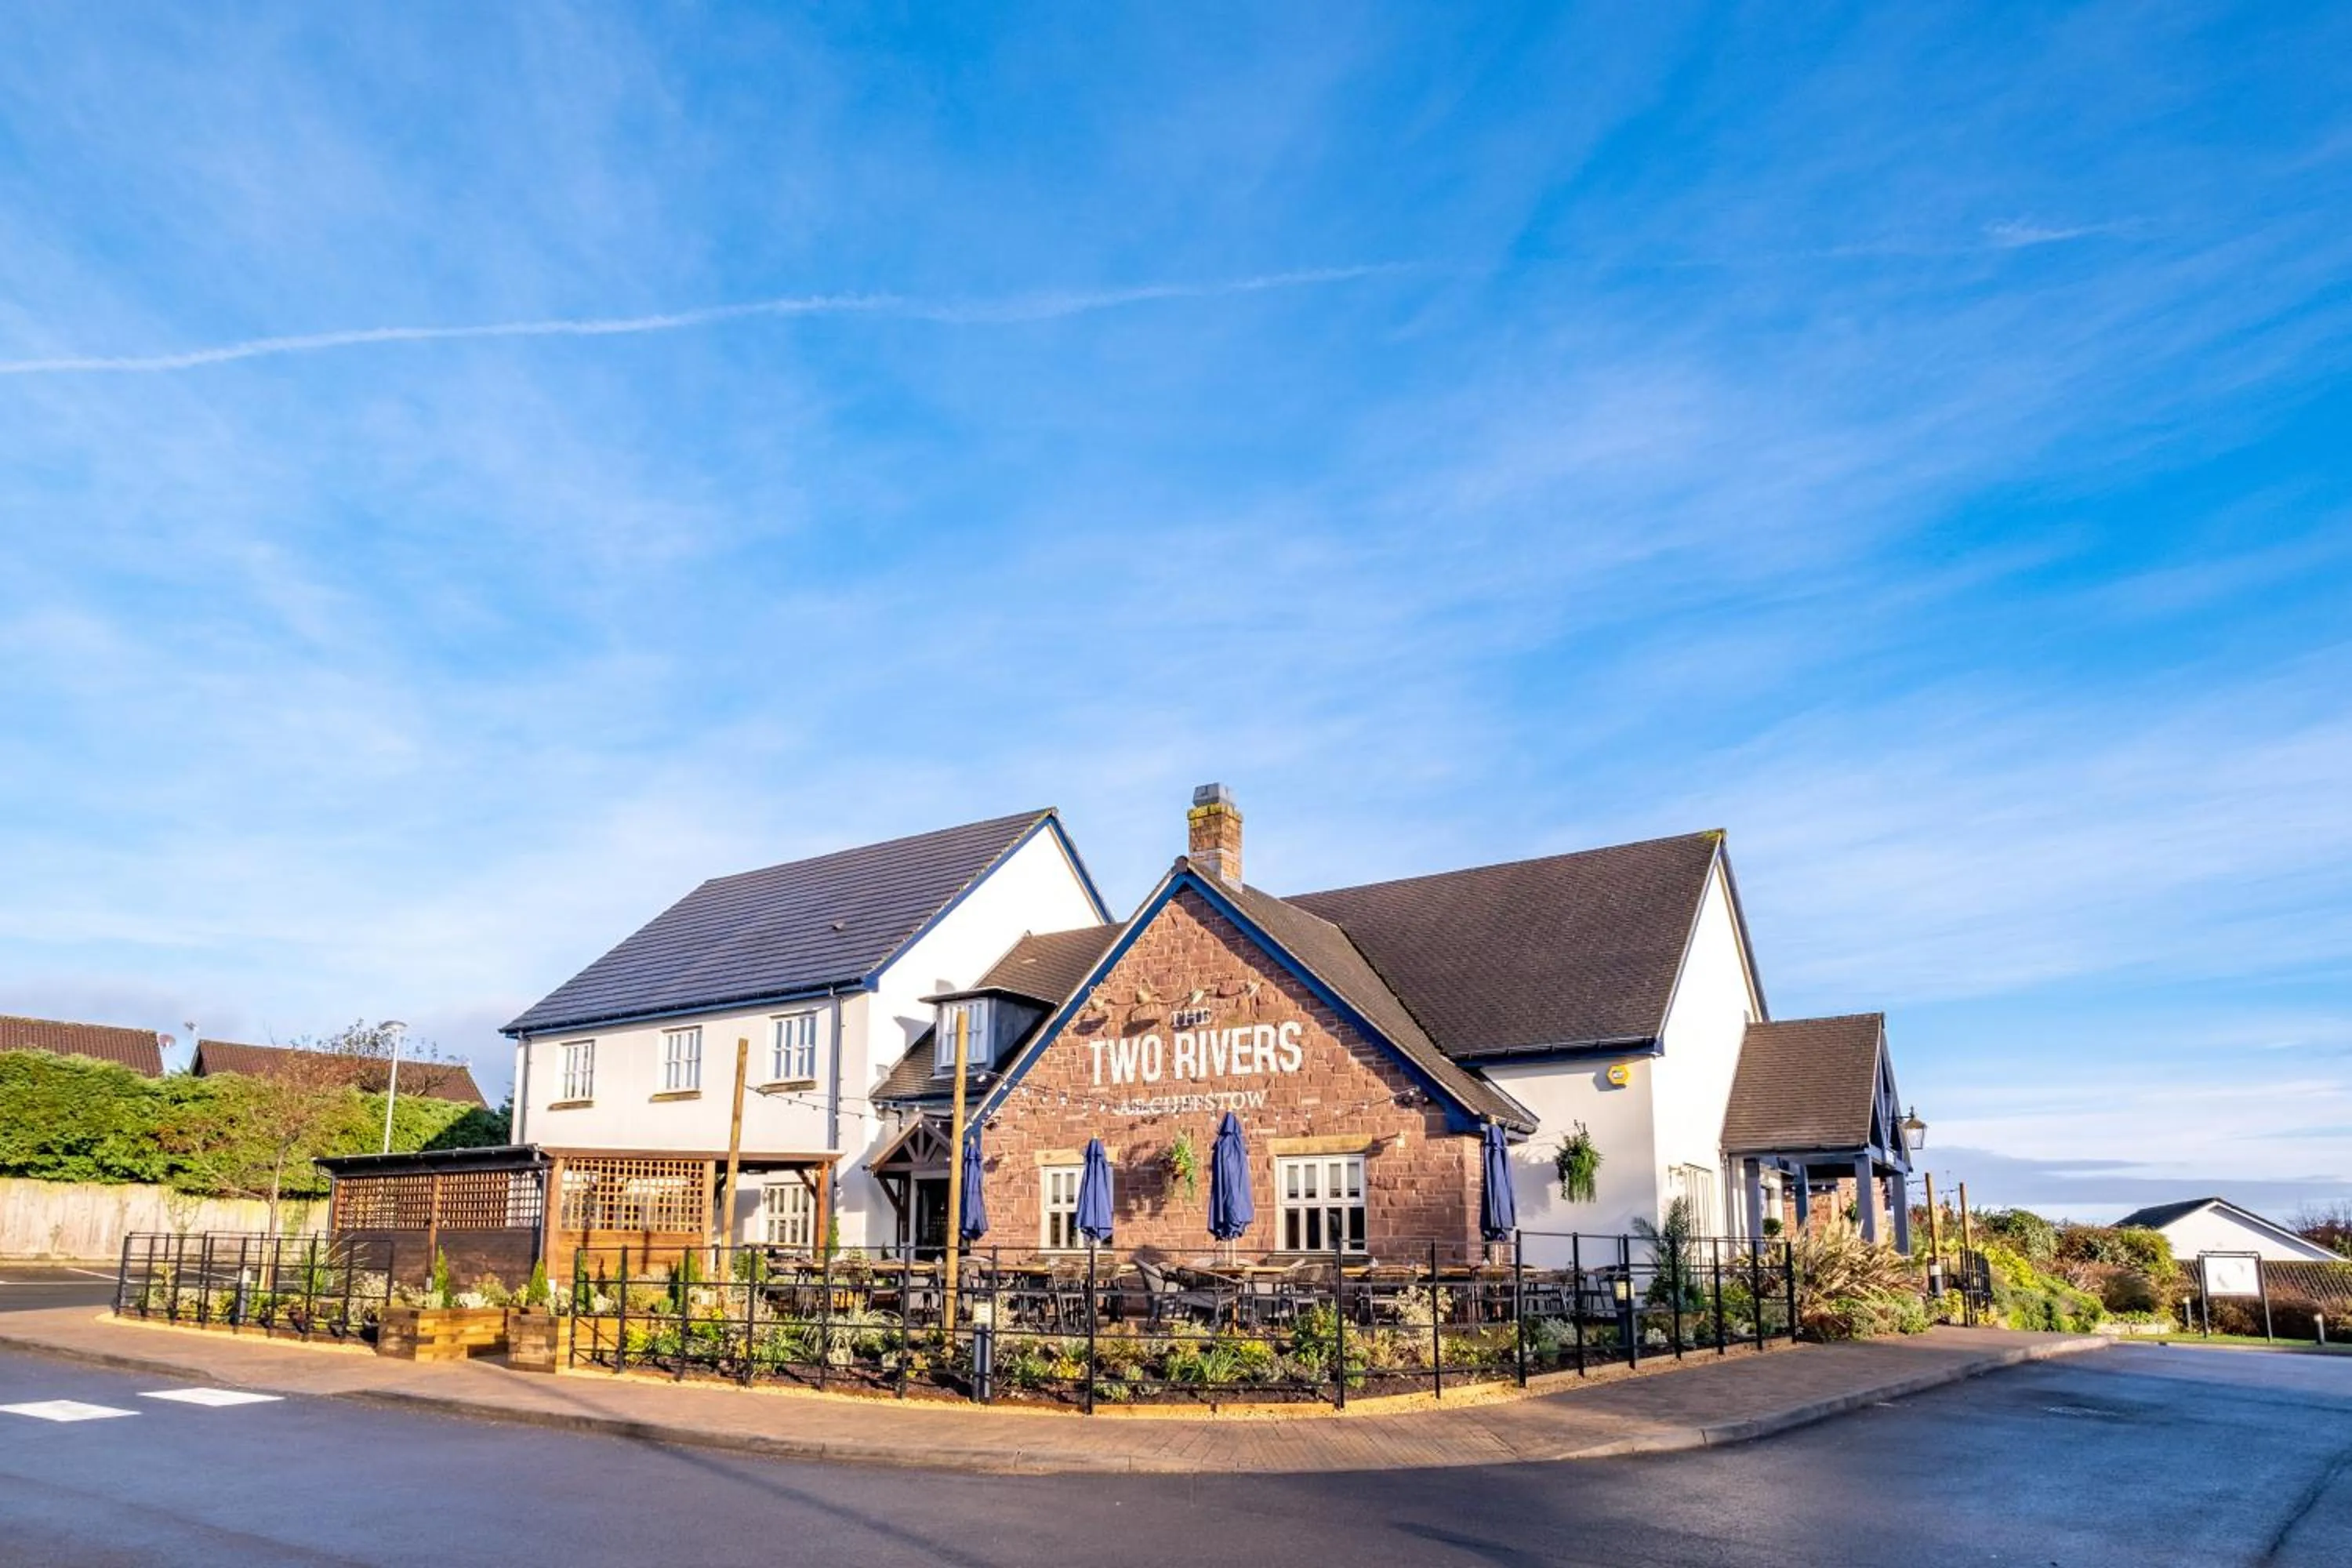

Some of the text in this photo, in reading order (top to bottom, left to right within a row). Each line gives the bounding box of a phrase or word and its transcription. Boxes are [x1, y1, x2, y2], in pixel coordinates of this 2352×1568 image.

[1171, 1008, 1210, 1027] THE
[1090, 1021, 1303, 1085] TWO RIVERS
